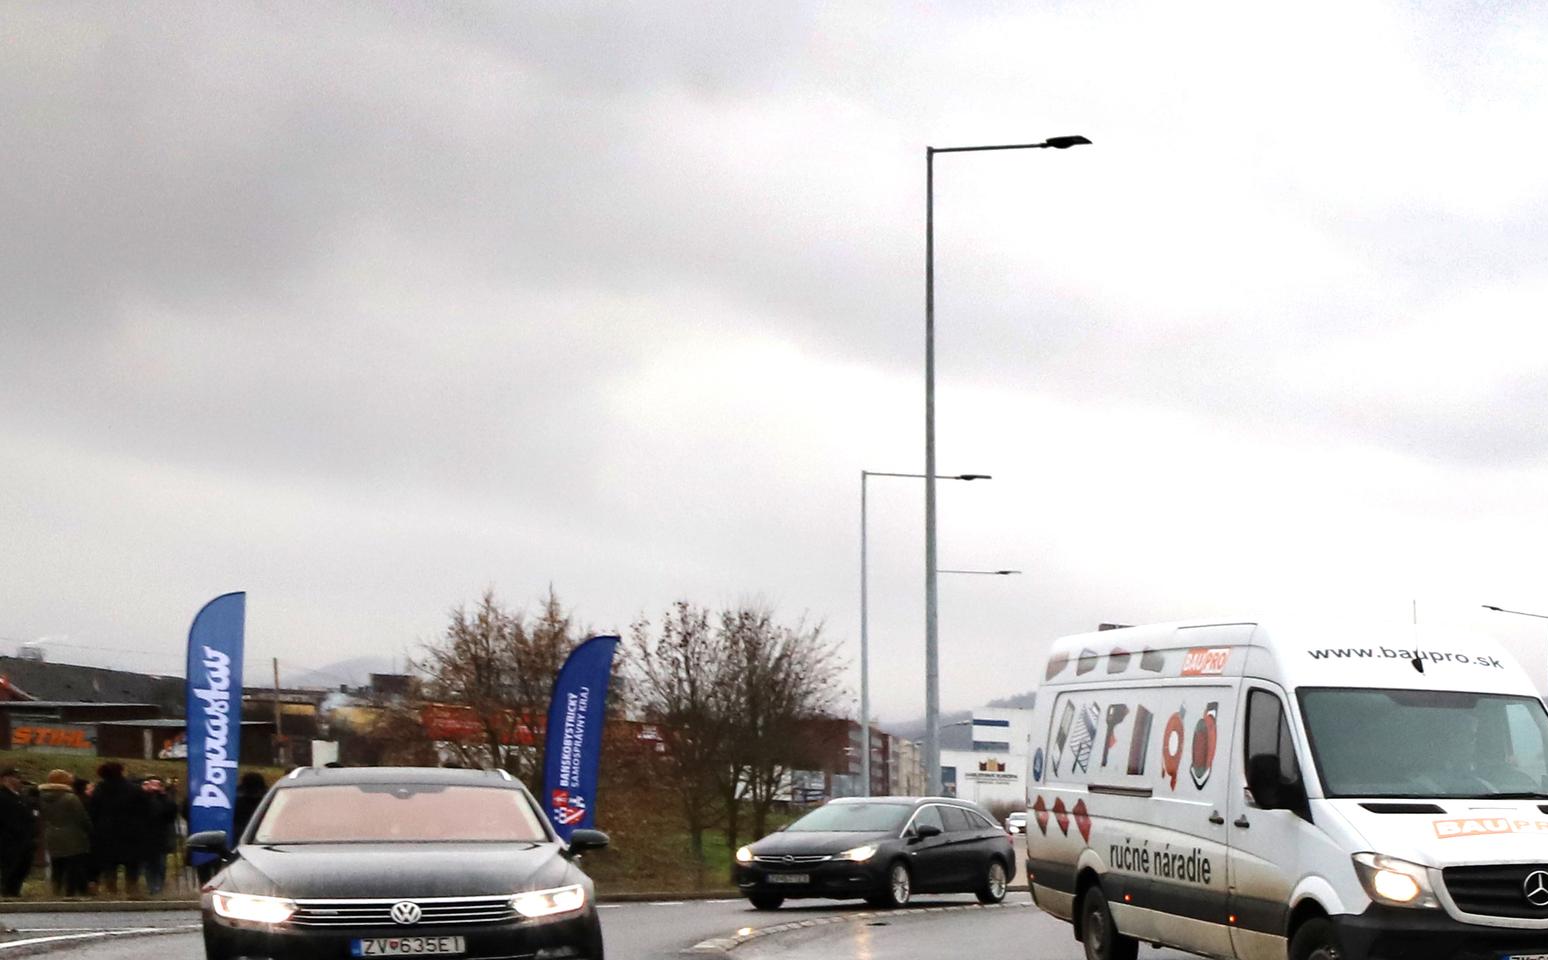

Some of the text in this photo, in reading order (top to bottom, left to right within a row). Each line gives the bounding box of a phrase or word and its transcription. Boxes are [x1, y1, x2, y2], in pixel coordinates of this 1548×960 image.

[1308, 645, 1504, 669] www.baupro.sk
[578, 686, 590, 712] KRAJ
[12, 725, 92, 749] STIHL
[1109, 837, 1212, 885] ručné náradie
